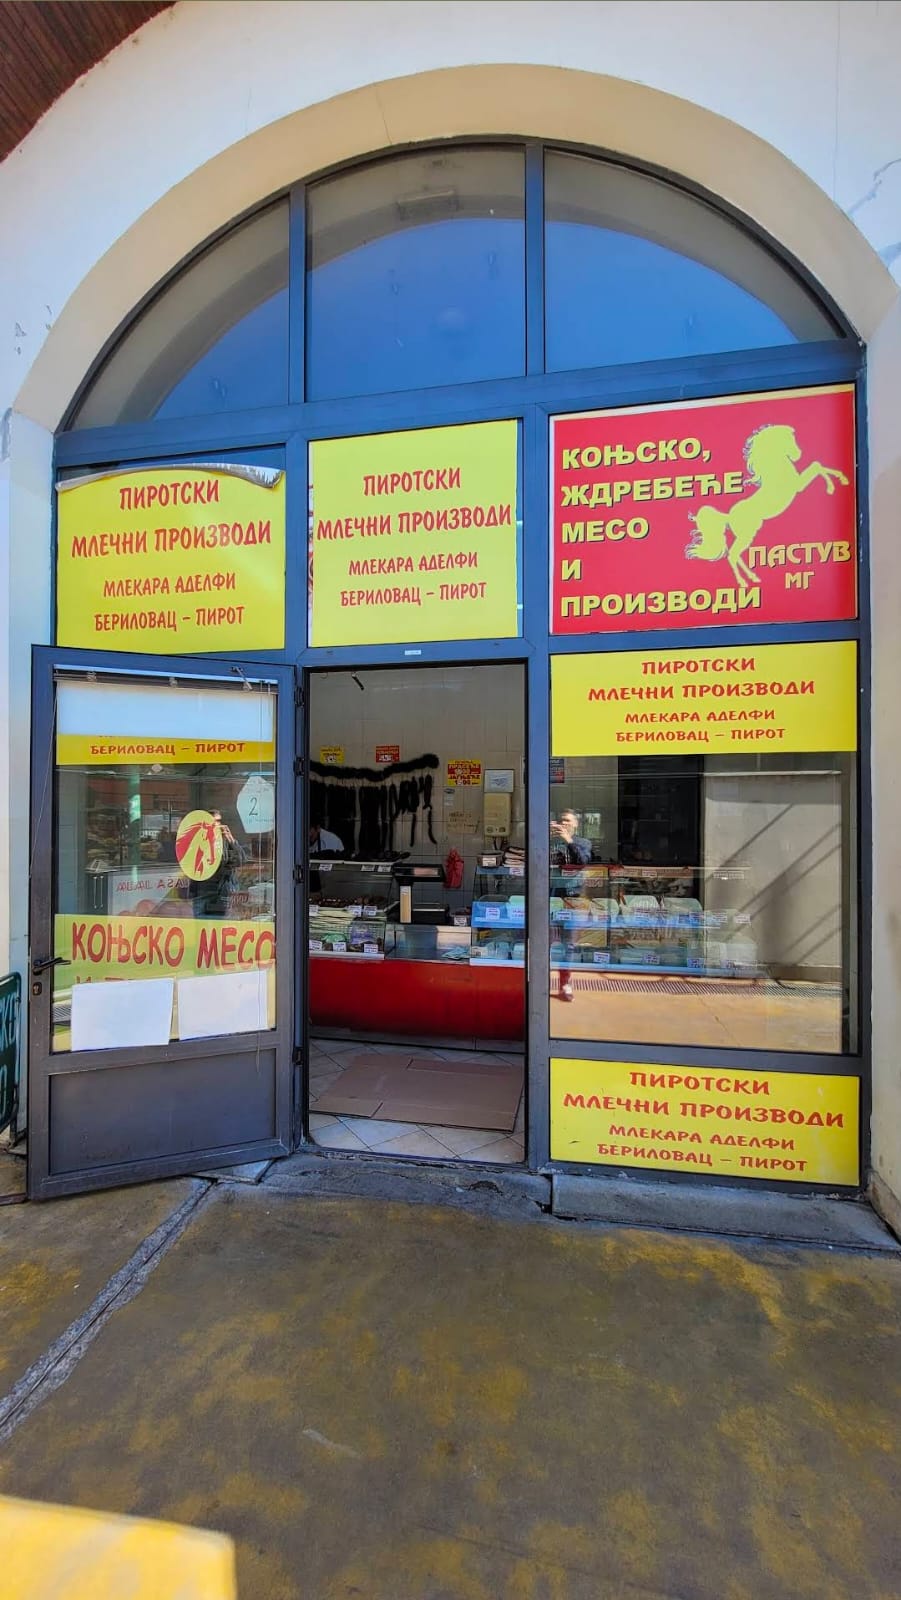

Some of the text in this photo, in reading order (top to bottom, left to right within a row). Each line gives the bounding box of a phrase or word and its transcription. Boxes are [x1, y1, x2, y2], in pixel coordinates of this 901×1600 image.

[562, 437, 711, 470] КОЊСКО,
[364, 467, 461, 496] ПИРОТСКИ
[561, 471, 744, 508] ЖДРЕБЕЋЕ
[120, 480, 219, 510] ПИРОТСКИ
[317, 504, 511, 540] МЛЕЧНИ ПРОИЗВОДИ
[562, 517, 650, 544] МЕСО
[72, 520, 271, 558] МЛЕЧНИ ПРОИЗВОДИ
[349, 552, 478, 576] МЛЕКАРА АДЕЛФИ
[749, 541, 852, 568] ПАСТУВ
[561, 559, 582, 581] И
[785, 571, 815, 589] МГ
[104, 572, 236, 598] МЛЕКАРА АДЕЛФИ
[341, 587, 421, 607] БЕРИЛОВАЦ
[439, 582, 487, 601] ПИРОТ
[561, 587, 761, 617] ПРОИЗВОДИ
[94, 611, 177, 632] БЕРИЛОВАЦ
[196, 606, 245, 626] ПИРОТ
[642, 657, 755, 675] ПИРОТСКИ
[588, 680, 815, 701] МЛЕЧНИ ПРОИЗВОДИ
[625, 709, 775, 724] МЛЕКАРА АДЕЛФИ
[616, 730, 709, 742] БЕРИЛОВАЦ
[731, 728, 785, 740] ПИРОТ
[90, 745, 175, 756] БЕРИЛОВАЦ
[196, 743, 245, 754] ПИРОТ
[249, 797, 258, 817] 2
[73, 923, 276, 971] КОЊСКО МЕСО
[629, 1072, 769, 1095] ПИРОТСКИ
[564, 1093, 844, 1128] МЛЕЧНИ ПРОИЗВОДИ
[609, 1124, 794, 1150] МЛЕКАРА АДЕЛФИ
[597, 1143, 713, 1166] БЕРИЛОВАЦ
[740, 1156, 807, 1172] ПИРОТ
